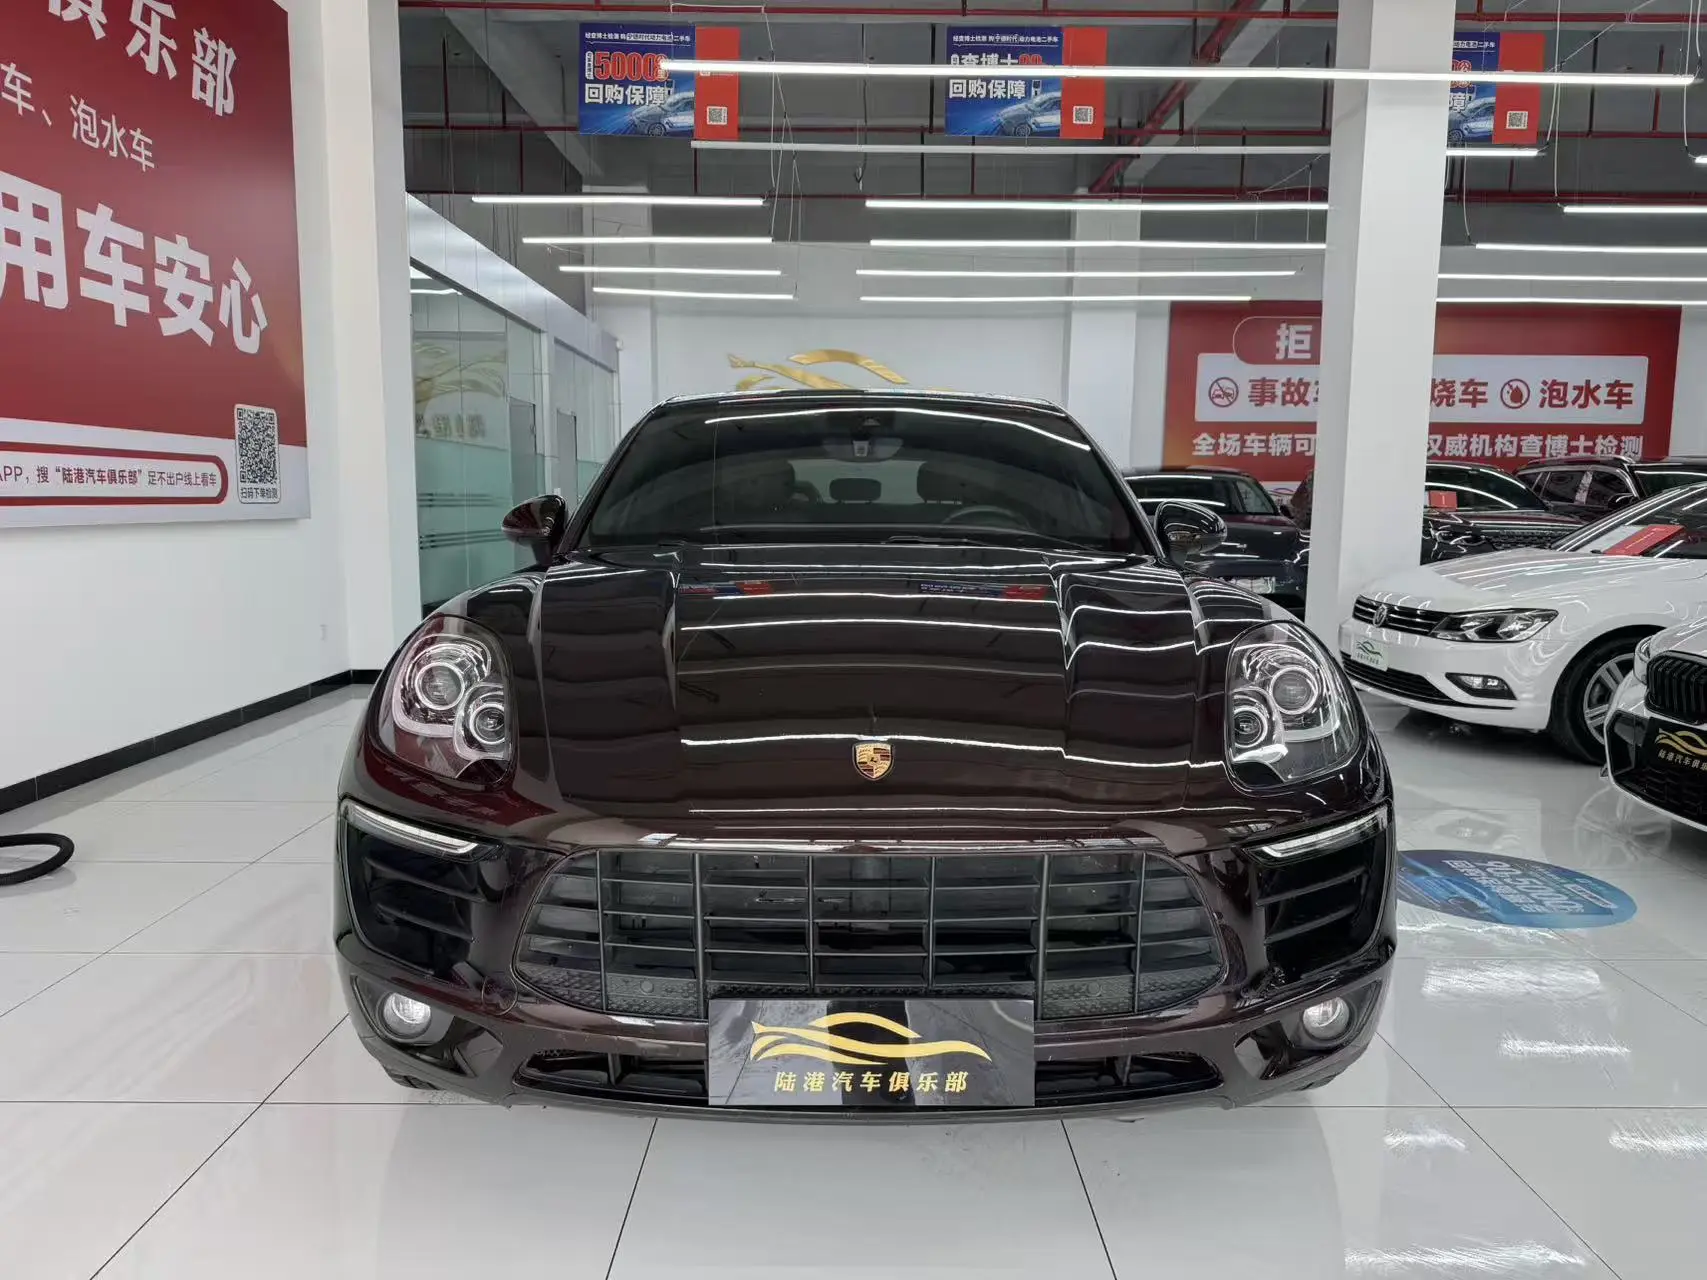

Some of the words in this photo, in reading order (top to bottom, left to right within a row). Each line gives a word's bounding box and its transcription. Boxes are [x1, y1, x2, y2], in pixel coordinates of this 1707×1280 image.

[585, 83, 666, 106] 回购保障
[949, 79, 1026, 99] 回购保障
[0, 171, 268, 354] 用车安心
[1275, 323, 1313, 360] 拒
[1247, 377, 1319, 407] 事故
[1539, 379, 1634, 409] 泡水车
[1192, 432, 1316, 457] 全场车辆可
[774, 1071, 969, 1093] 陆港汽车俱乐部
